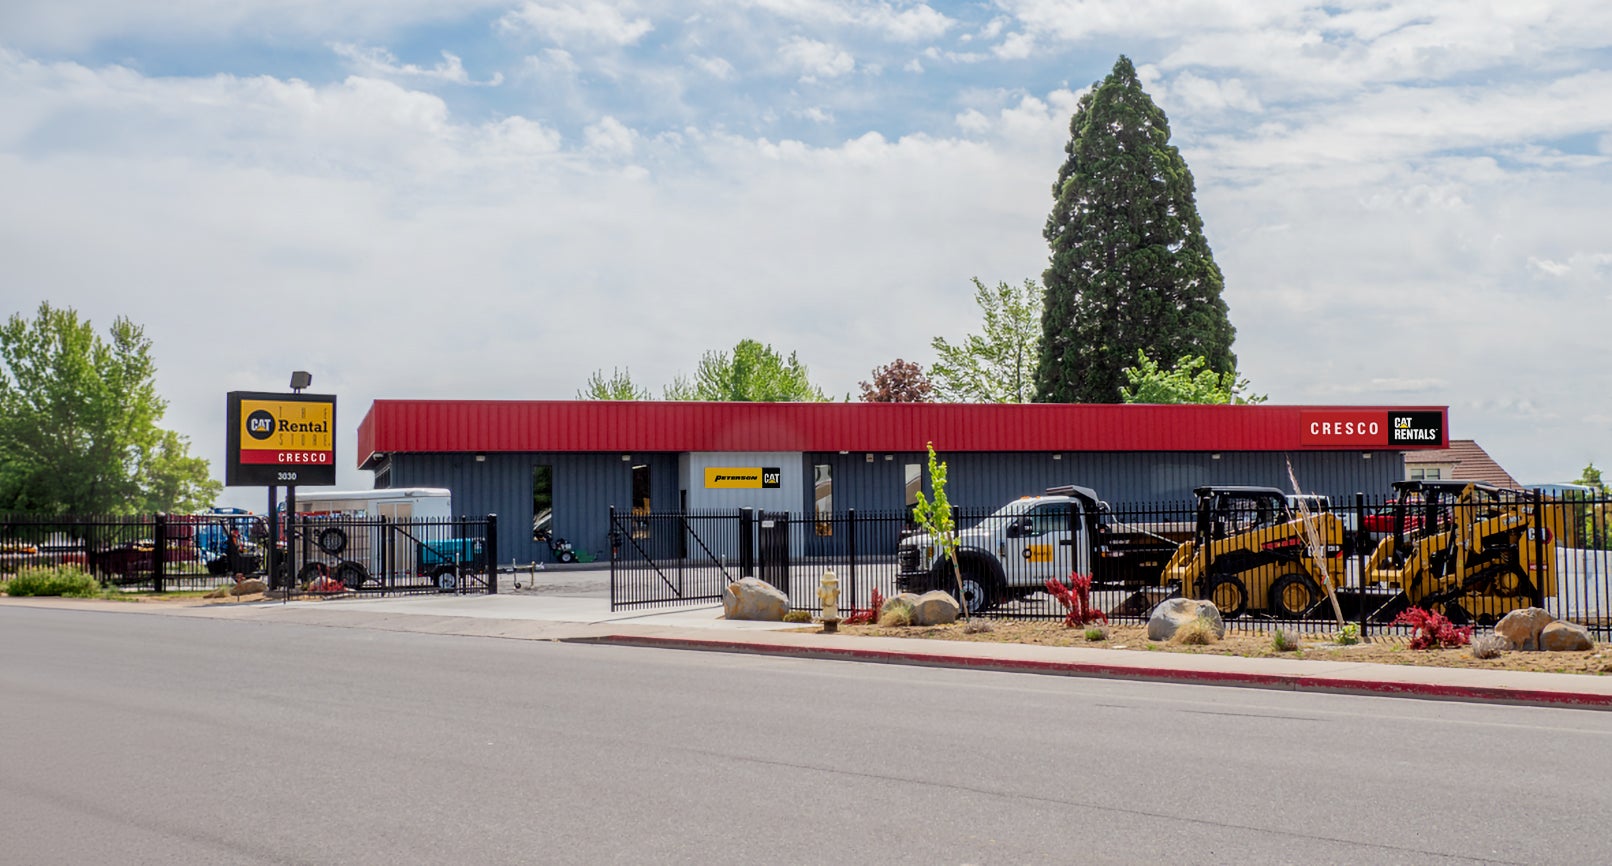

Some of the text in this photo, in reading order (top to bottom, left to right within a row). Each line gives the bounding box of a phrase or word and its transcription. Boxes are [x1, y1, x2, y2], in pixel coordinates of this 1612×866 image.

[278, 406, 328, 419] THE
[250, 418, 271, 432] CAT
[278, 419, 328, 432] Rental
[1394, 417, 1412, 428] CAT
[1310, 422, 1379, 435] CRESCO
[1394, 429, 1436, 440] RENTALS
[278, 453, 326, 462] CRESCO
[278, 472, 297, 480] 3030
[764, 473, 780, 484] CAT
